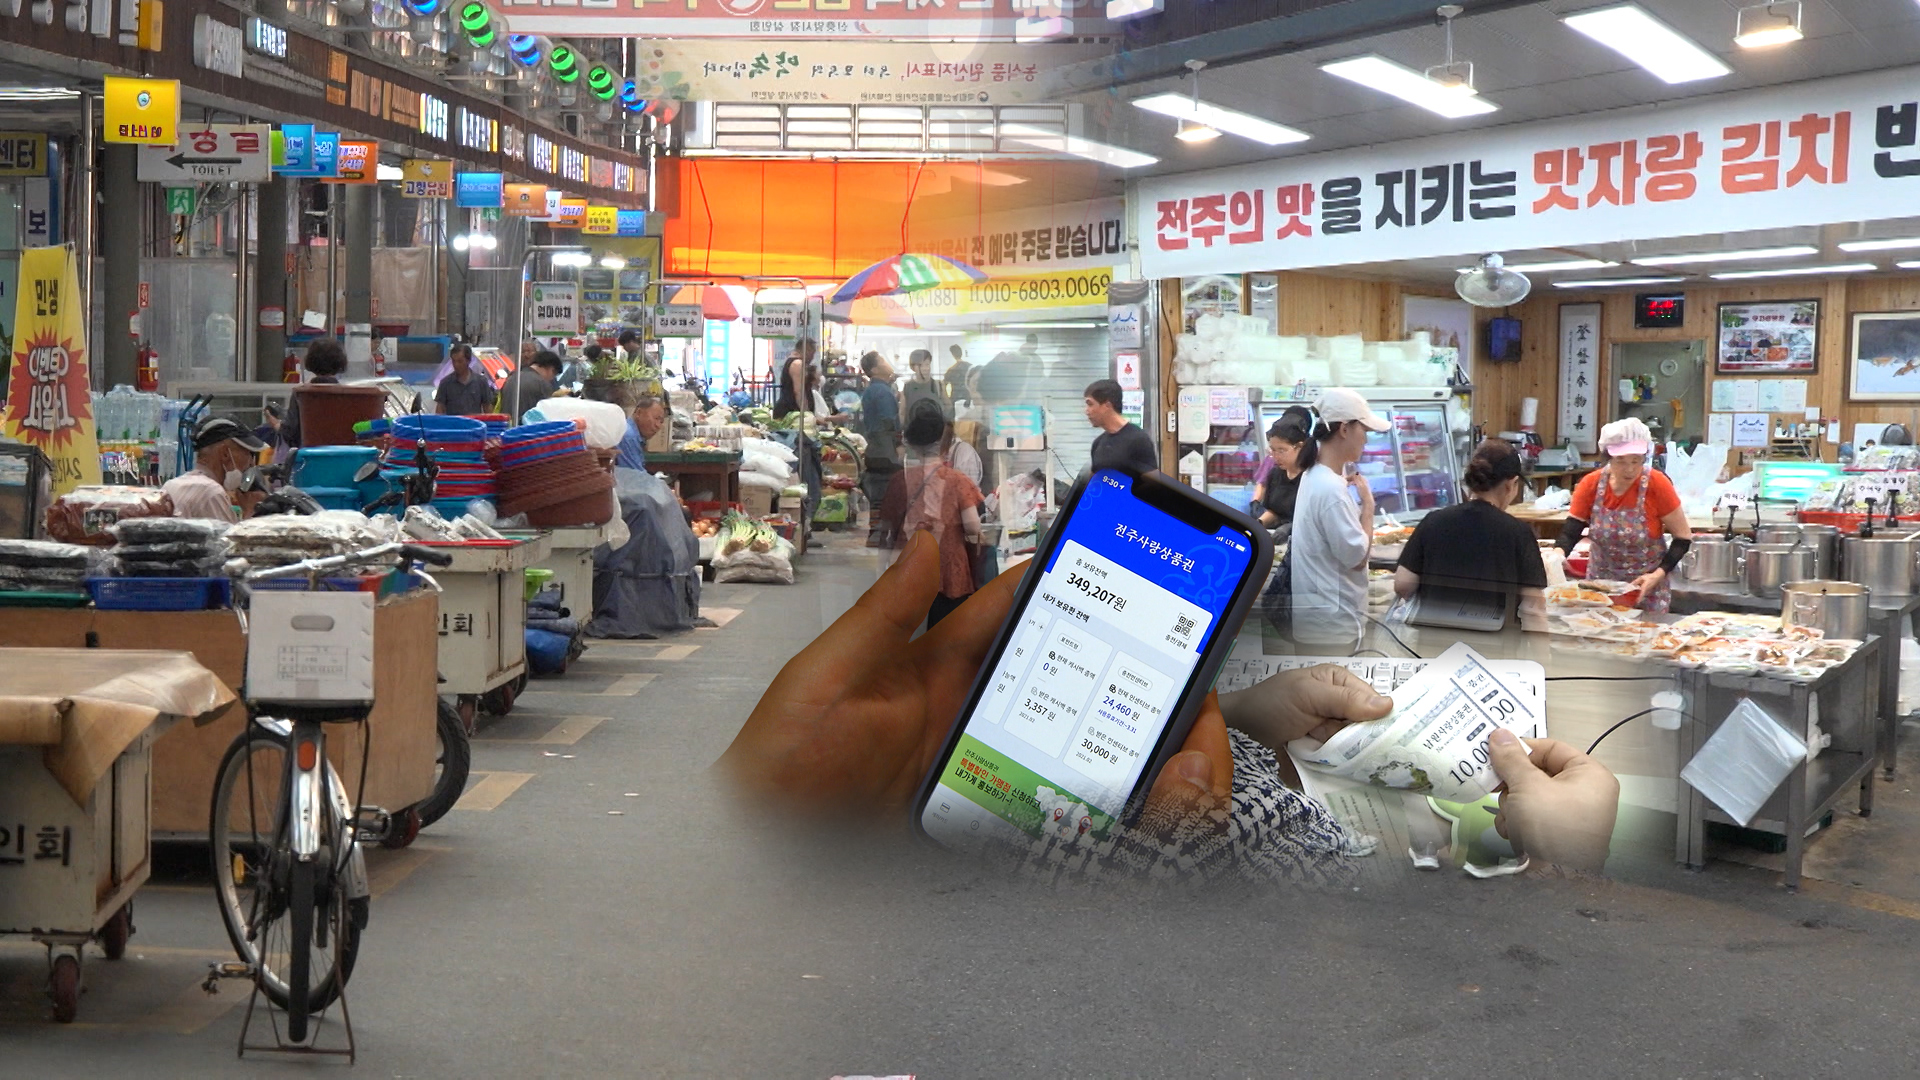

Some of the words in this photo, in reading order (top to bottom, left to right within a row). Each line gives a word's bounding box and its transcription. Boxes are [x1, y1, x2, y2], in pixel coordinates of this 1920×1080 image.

[191, 165, 233, 176] TOILET
[1156, 190, 1264, 251] 전주의
[1276, 177, 1362, 237] 맛을
[1375, 160, 1517, 229] 지키는
[1532, 130, 1704, 215] 맛자랑
[1721, 110, 1852, 195] 김치
[989, 231, 1019, 266] 예약
[1021, 227, 1052, 262] 주문
[1055, 219, 1127, 258] 받습니다.
[35, 279, 59, 316] 민생
[1102, 475, 1120, 489] 9:30
[1114, 522, 1196, 574] 전주사랑상품권
[1225, 538, 1236, 548] LTE
[1082, 562, 1109, 580] 보유잔액
[1066, 572, 1127, 612] 349,207원
[1042, 592, 1056, 606] 내가
[1055, 599, 1076, 617] 보유한
[1075, 609, 1091, 624] 잔액
[1015, 647, 1024, 658] 원
[1042, 662, 1049, 671] 0
[1049, 666, 1058, 676] 원
[1024, 698, 1048, 716] 3,357
[1047, 711, 1057, 722] 원
[1102, 695, 1132, 716] 24,460
[1131, 711, 1141, 722] 원
[964, 749, 1000, 773] 전주사랑상품권
[1081, 738, 1110, 759] 30,000
[1109, 754, 1119, 765] 원
[954, 767, 978, 786] 내가게
[960, 757, 989, 780] 특별할인
[988, 773, 1012, 793] 가맹점
[1011, 787, 1041, 810] 신청하고
